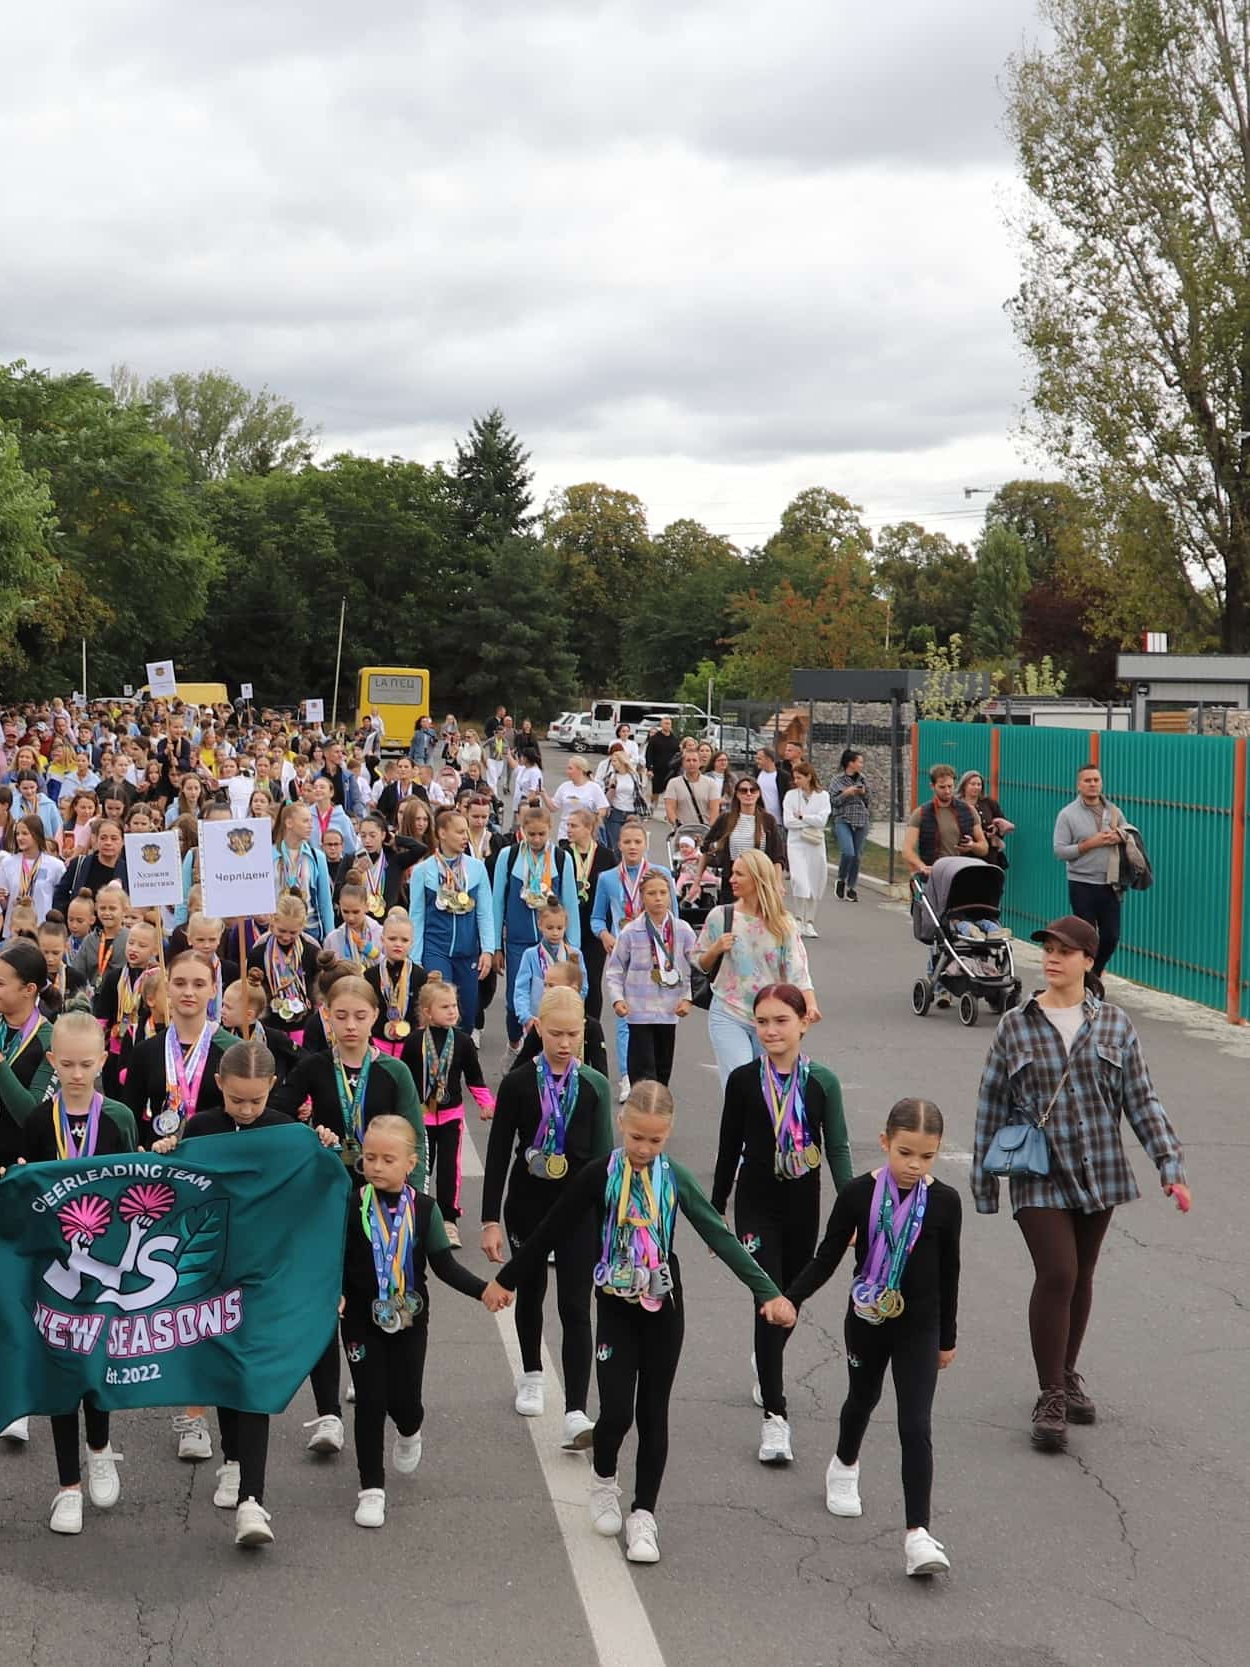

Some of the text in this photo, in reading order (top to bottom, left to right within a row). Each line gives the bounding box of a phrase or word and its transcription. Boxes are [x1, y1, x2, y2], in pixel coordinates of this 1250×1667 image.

[215, 871, 270, 882] Черліденг
[32, 1163, 212, 1213] CEERLEADING TEAM
[34, 1288, 243, 1358] NEW SEASONS
[106, 1363, 161, 1385] Est.2022
